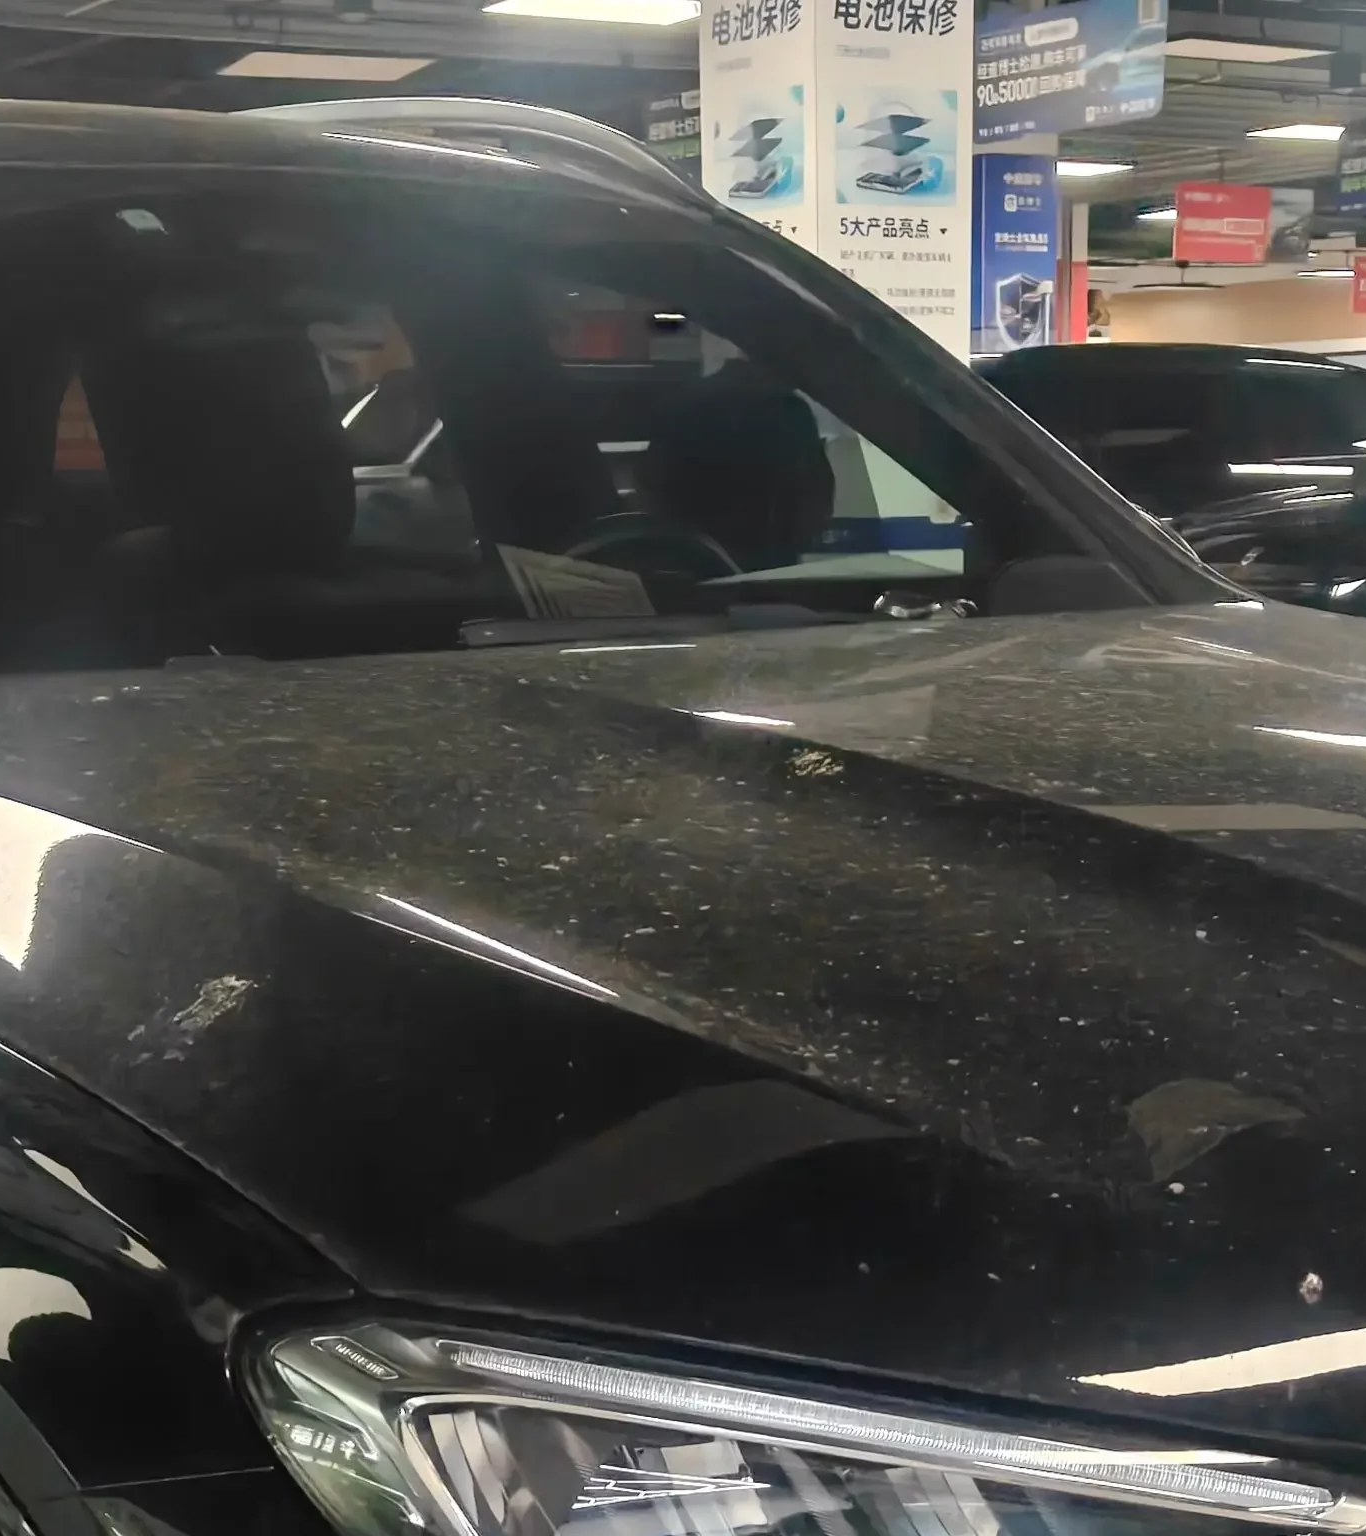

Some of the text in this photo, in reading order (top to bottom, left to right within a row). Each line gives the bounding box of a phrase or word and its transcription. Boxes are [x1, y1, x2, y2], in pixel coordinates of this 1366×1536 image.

[712, 0, 802, 46] 电池保修
[834, 0, 958, 37] 电池保修
[839, 216, 929, 239] 5大产品亮点
